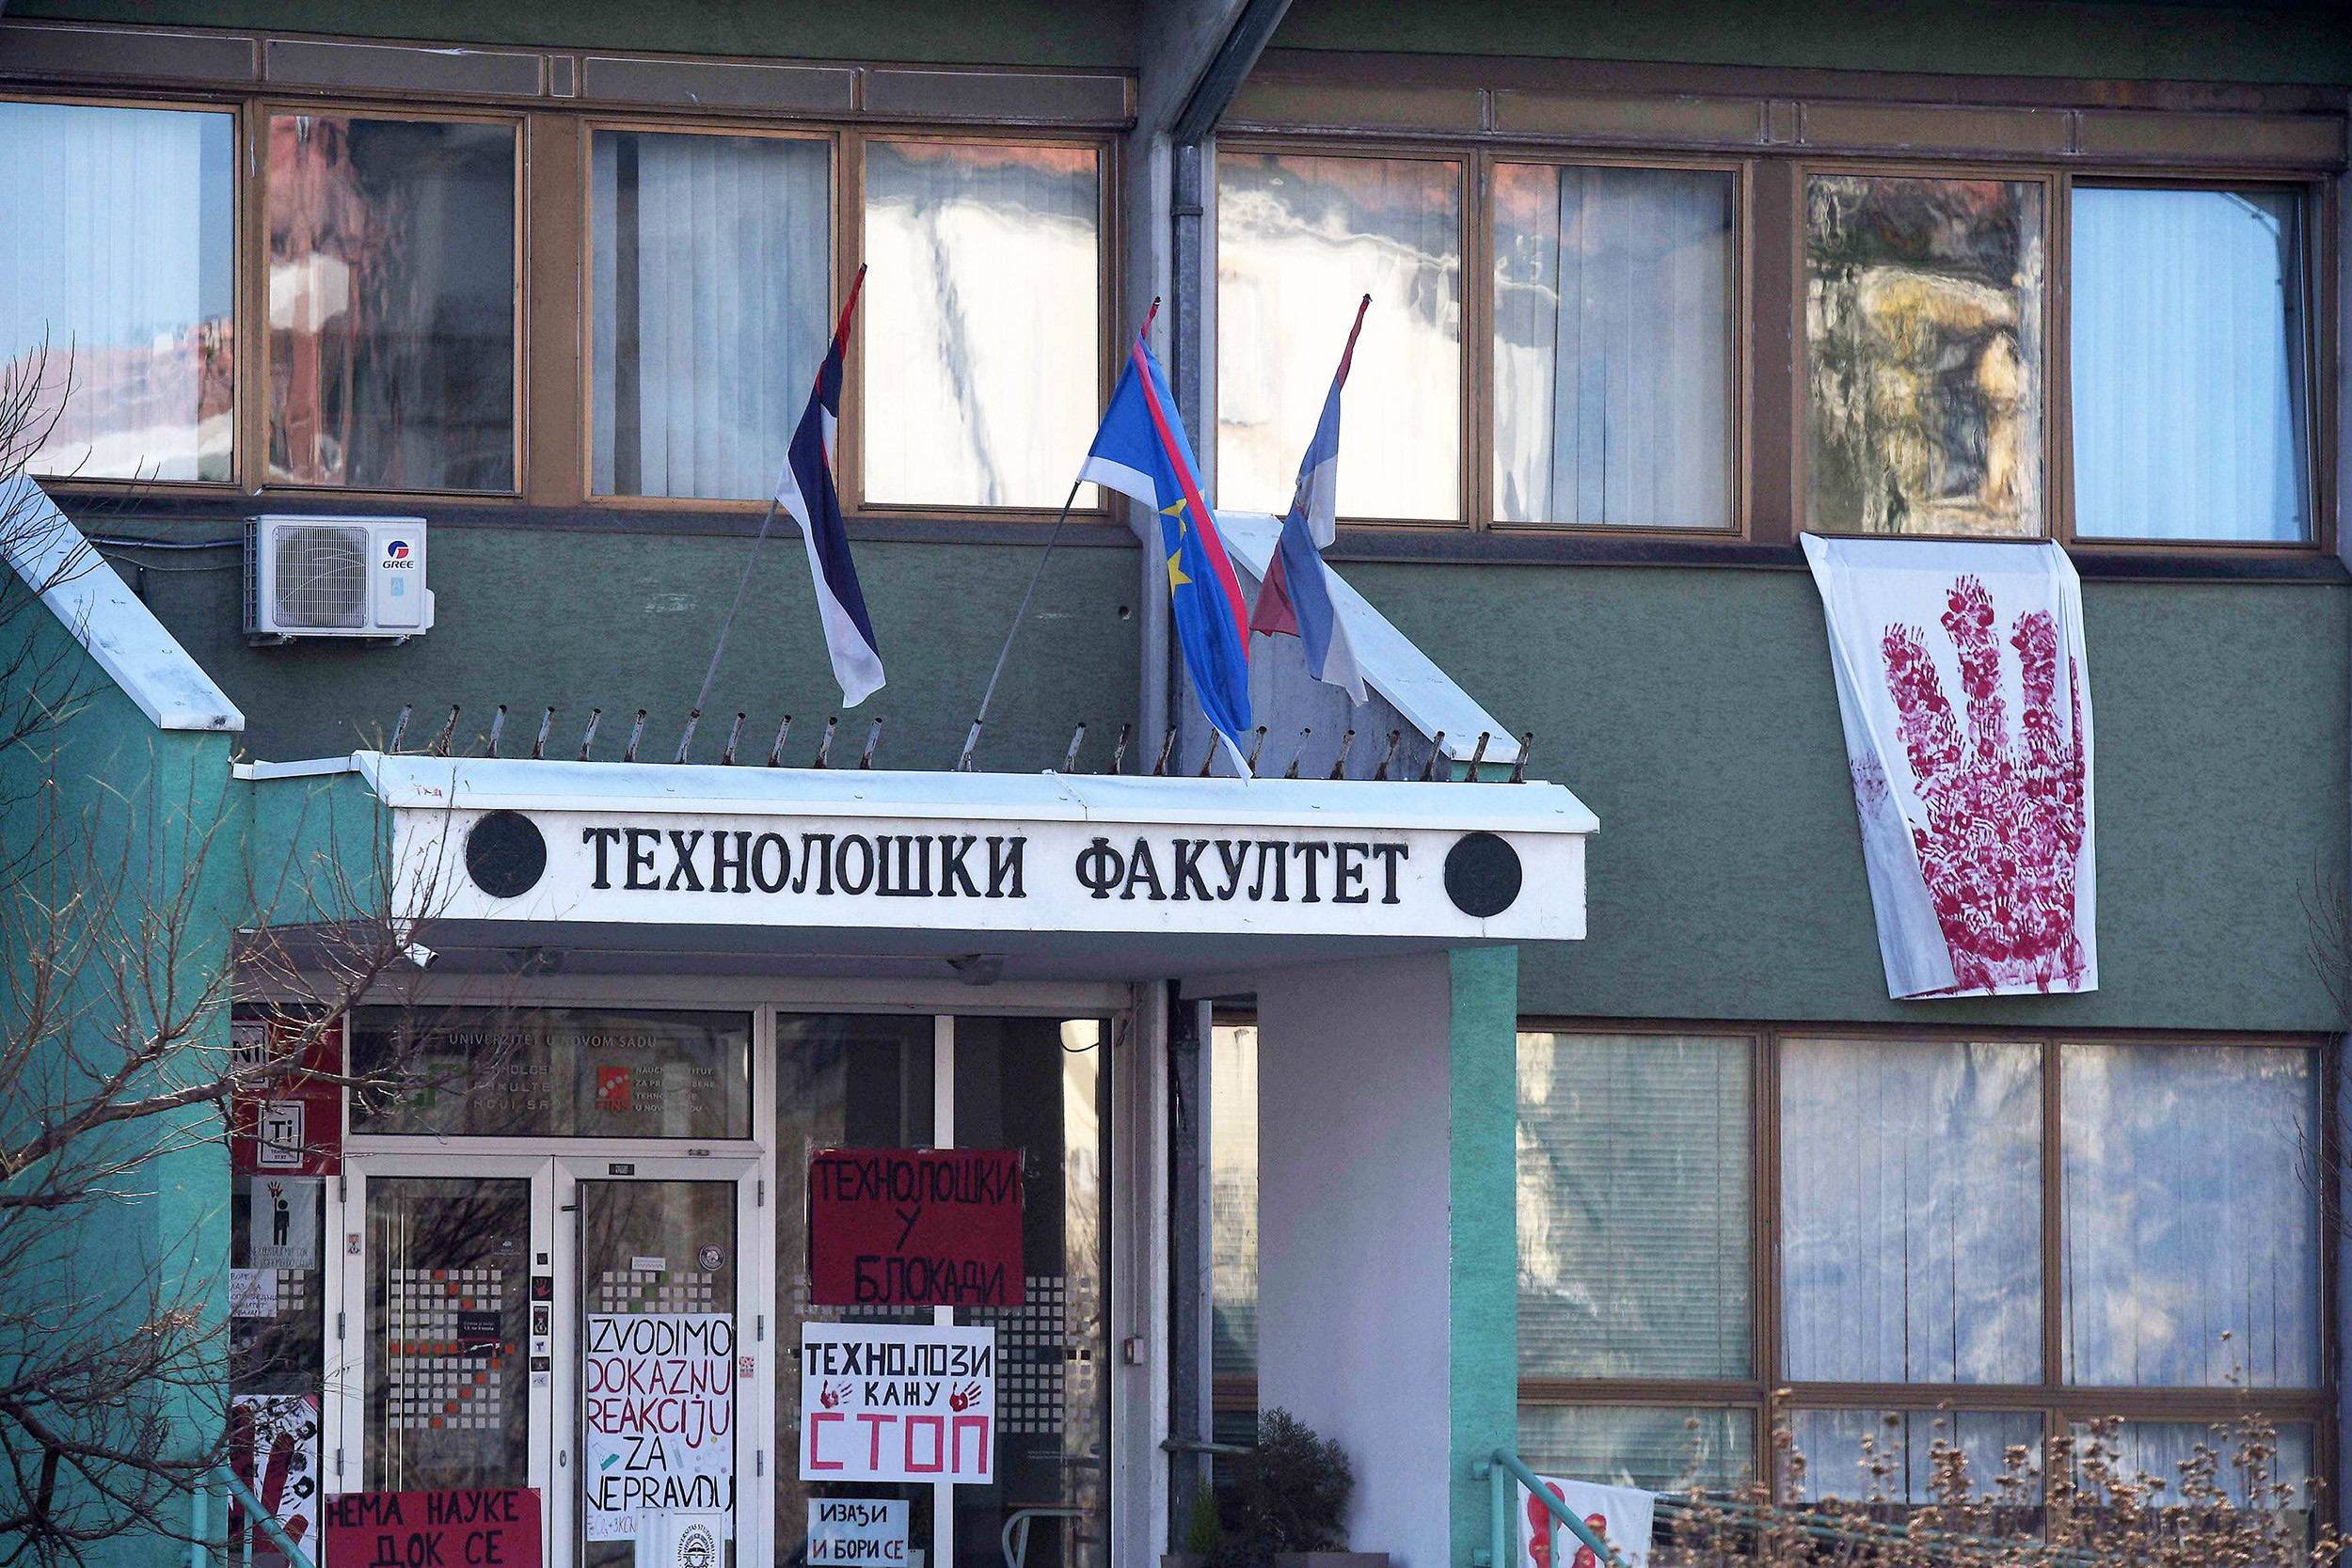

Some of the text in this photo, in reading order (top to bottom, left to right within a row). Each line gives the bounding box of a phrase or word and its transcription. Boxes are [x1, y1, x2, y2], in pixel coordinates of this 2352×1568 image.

[382, 560, 414, 569] GREE
[582, 826, 1409, 904] ТЕХНОЛОШКИ ФАКУЛТЕТ
[619, 1036, 657, 1048] SADU
[269, 1119, 294, 1143] Ti
[813, 1156, 1017, 1205] ТЕХНОЛОШКИ
[896, 1206, 922, 1252] У
[854, 1254, 1005, 1306] БЛОКАДИ
[587, 1318, 732, 1356] IZVODIMO
[587, 1357, 731, 1396] DOKAZNU
[804, 1342, 991, 1378] ТЕХНОЛОЗИ
[865, 1381, 941, 1406] КАЖУ
[587, 1395, 731, 1449] REAKCIJU
[623, 1435, 667, 1472] ZA
[810, 1412, 990, 1474] СТОП
[328, 1491, 520, 1528] НЕМА НАУКЕ
[370, 1529, 503, 1568] ДОК СЕ
[813, 1539, 903, 1560] И БОРИ СЕ
